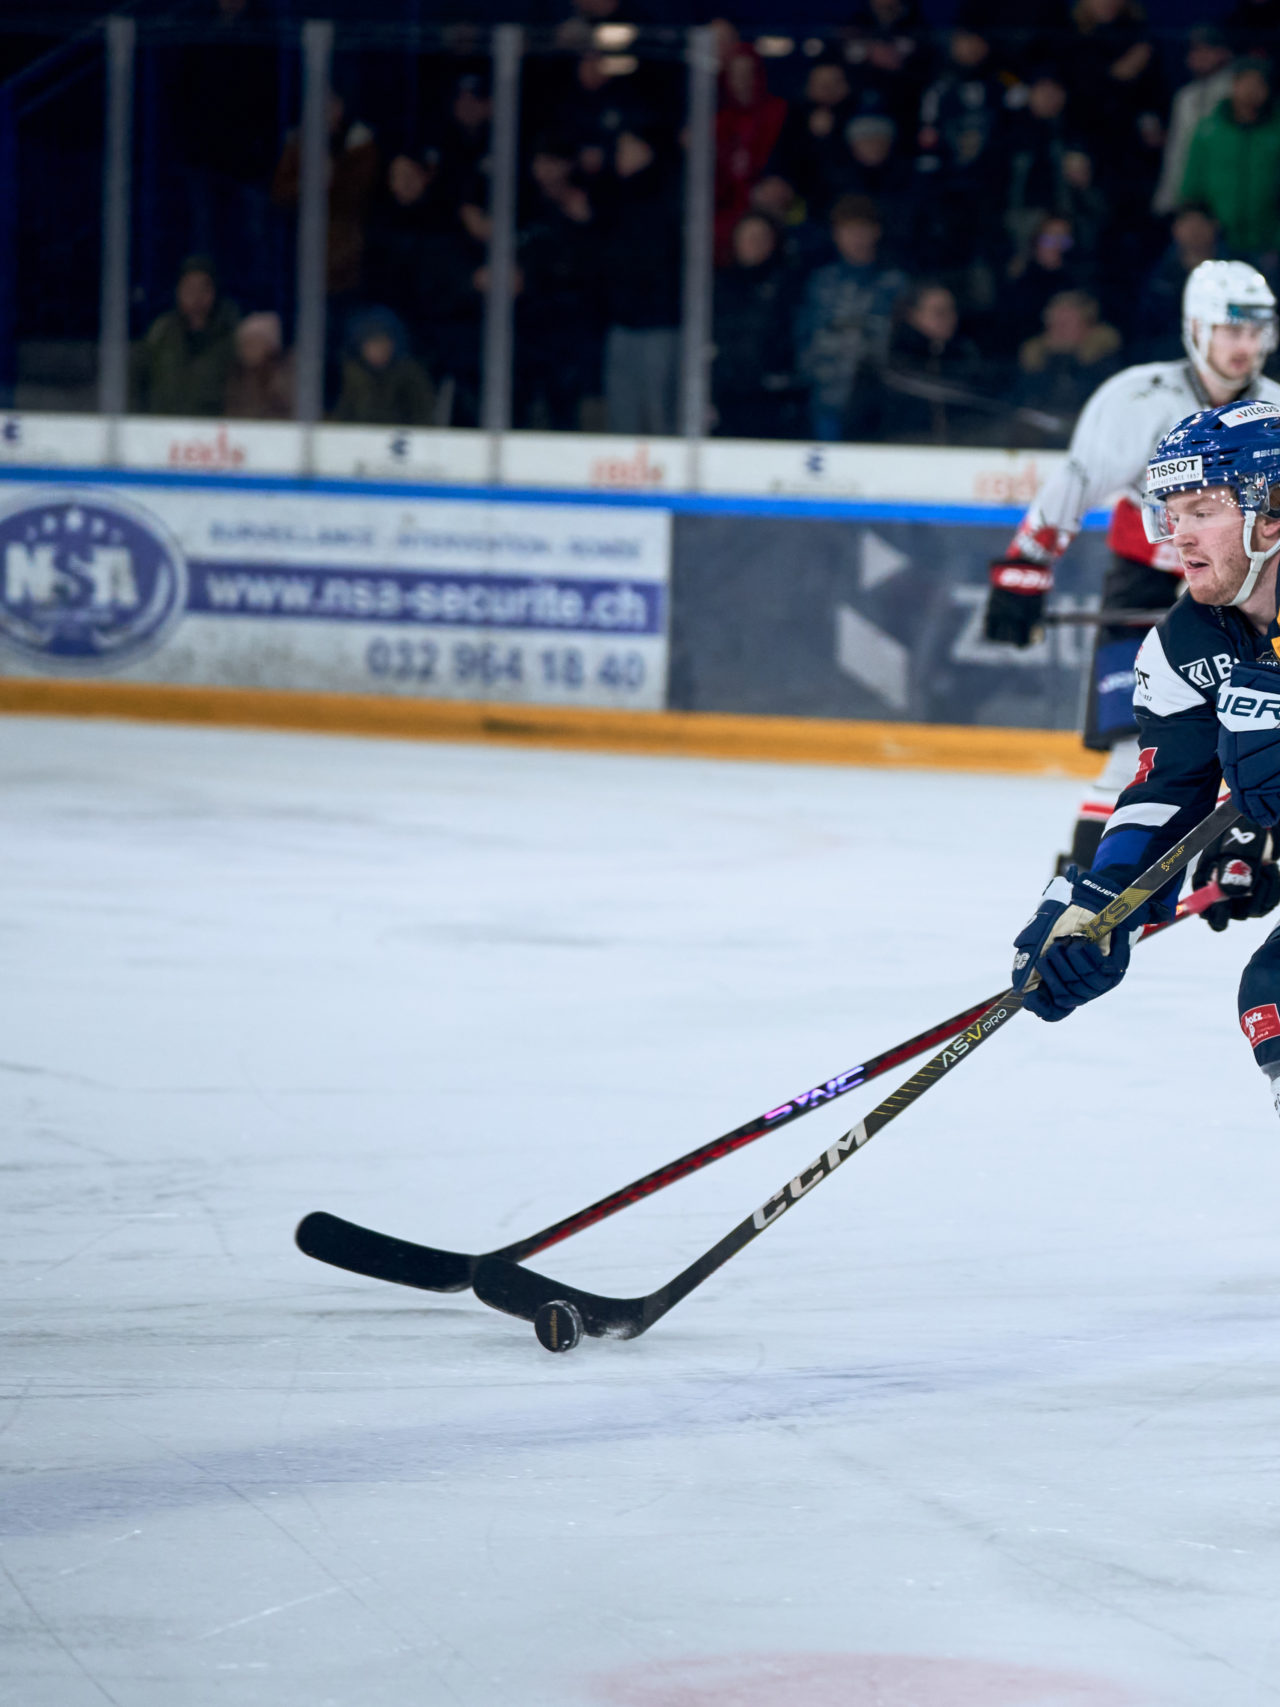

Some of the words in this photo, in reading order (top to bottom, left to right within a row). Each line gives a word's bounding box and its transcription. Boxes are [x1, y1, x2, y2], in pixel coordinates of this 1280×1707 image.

[1240, 404, 1280, 418] viteos
[1150, 459, 1199, 479] TISSOT
[5, 542, 139, 607] NSA
[205, 572, 648, 630] www.nsa-securite.ch
[365, 637, 438, 683] 032
[453, 641, 523, 685] 964
[542, 646, 584, 690] 18
[598, 650, 646, 693] 40
[982, 1008, 1007, 1032] PRO
[752, 1119, 868, 1230] CCM
